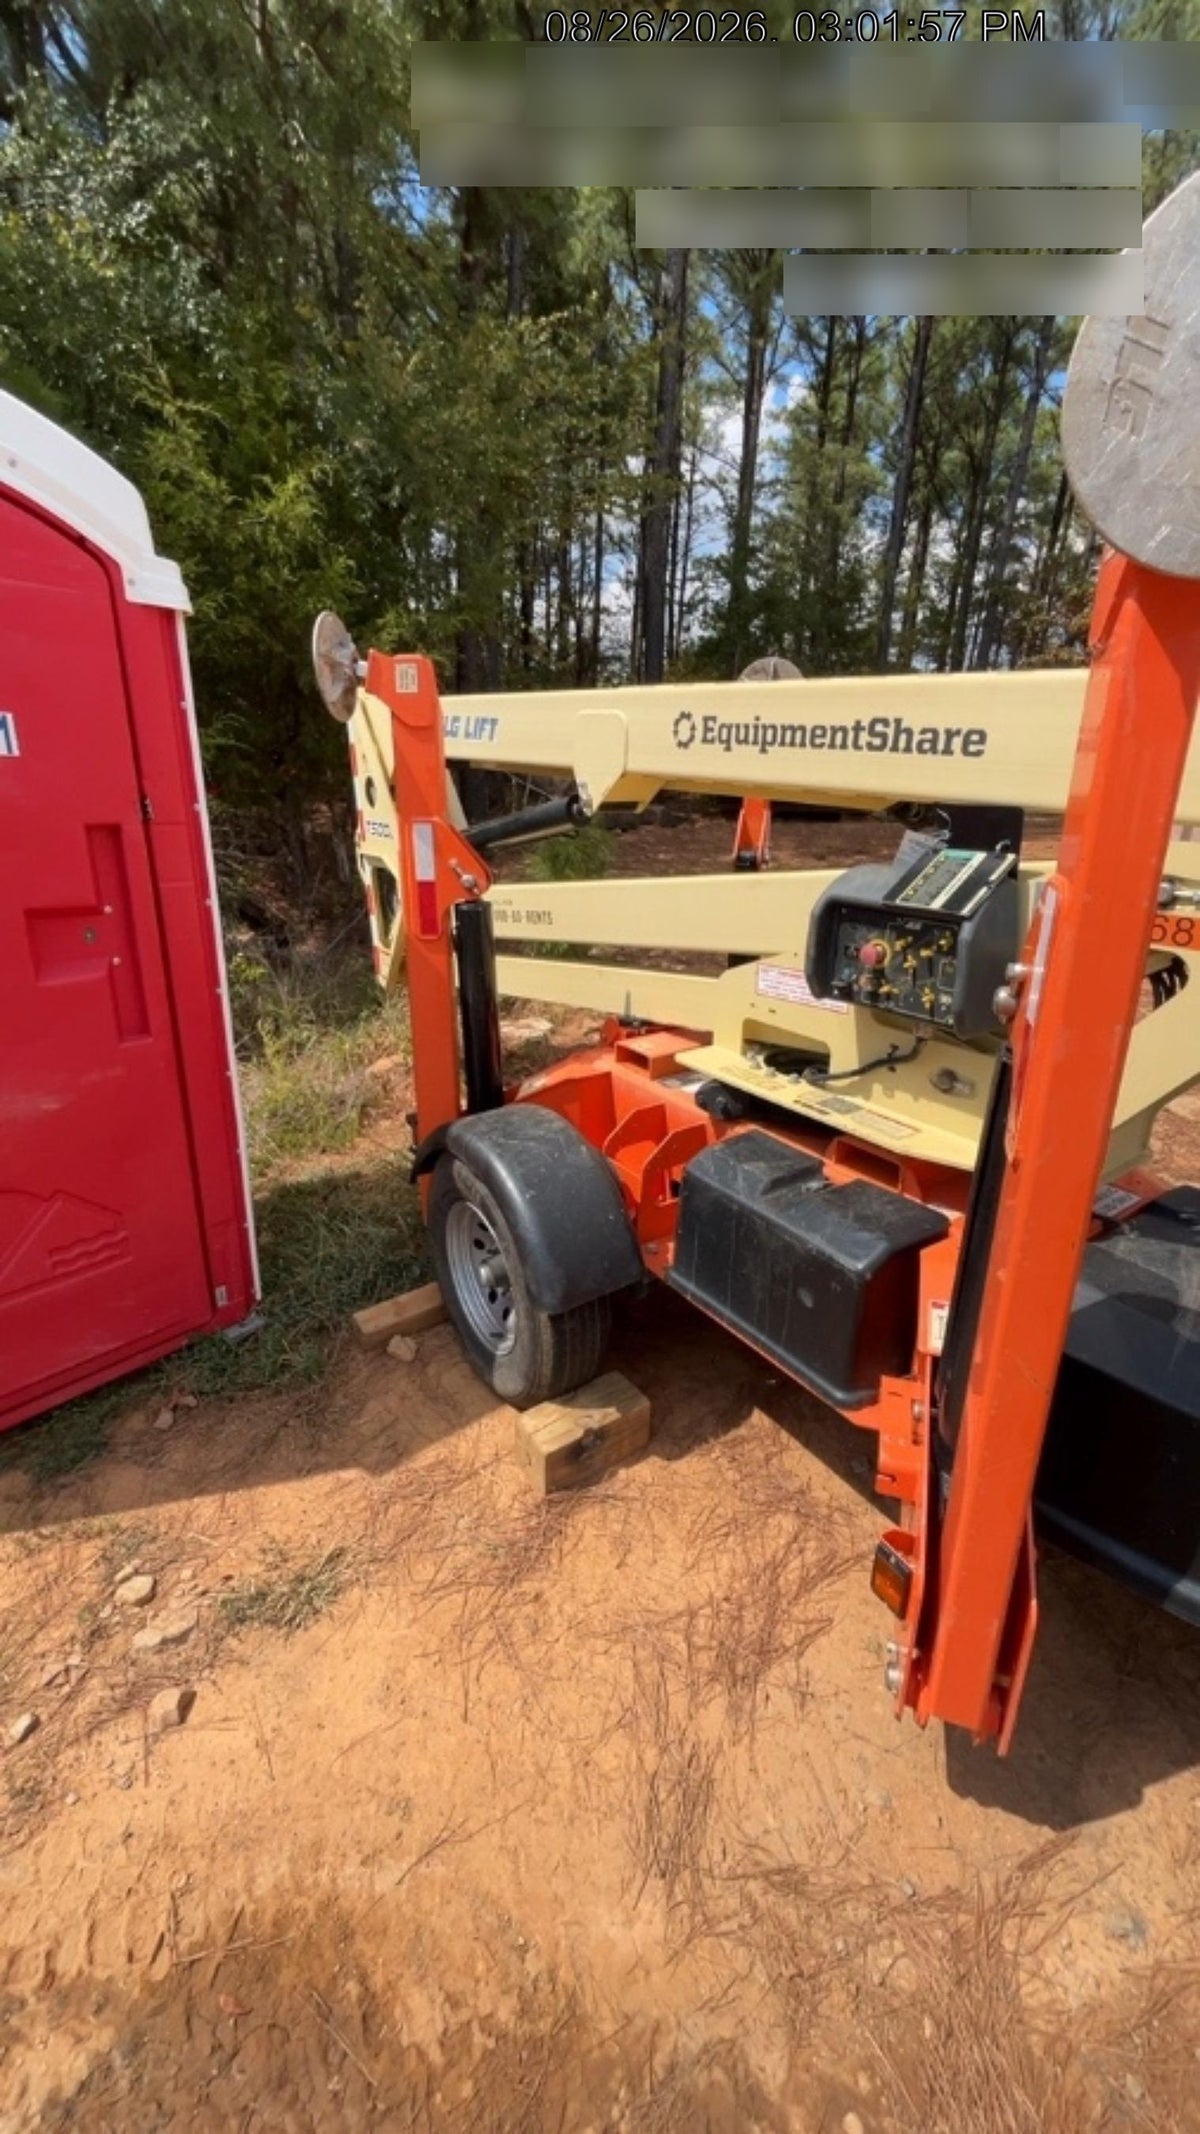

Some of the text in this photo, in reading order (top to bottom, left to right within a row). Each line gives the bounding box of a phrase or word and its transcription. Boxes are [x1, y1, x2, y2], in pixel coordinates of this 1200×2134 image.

[443, 715, 499, 741] LG LIFT
[700, 715, 987, 757] EquipmentShare
